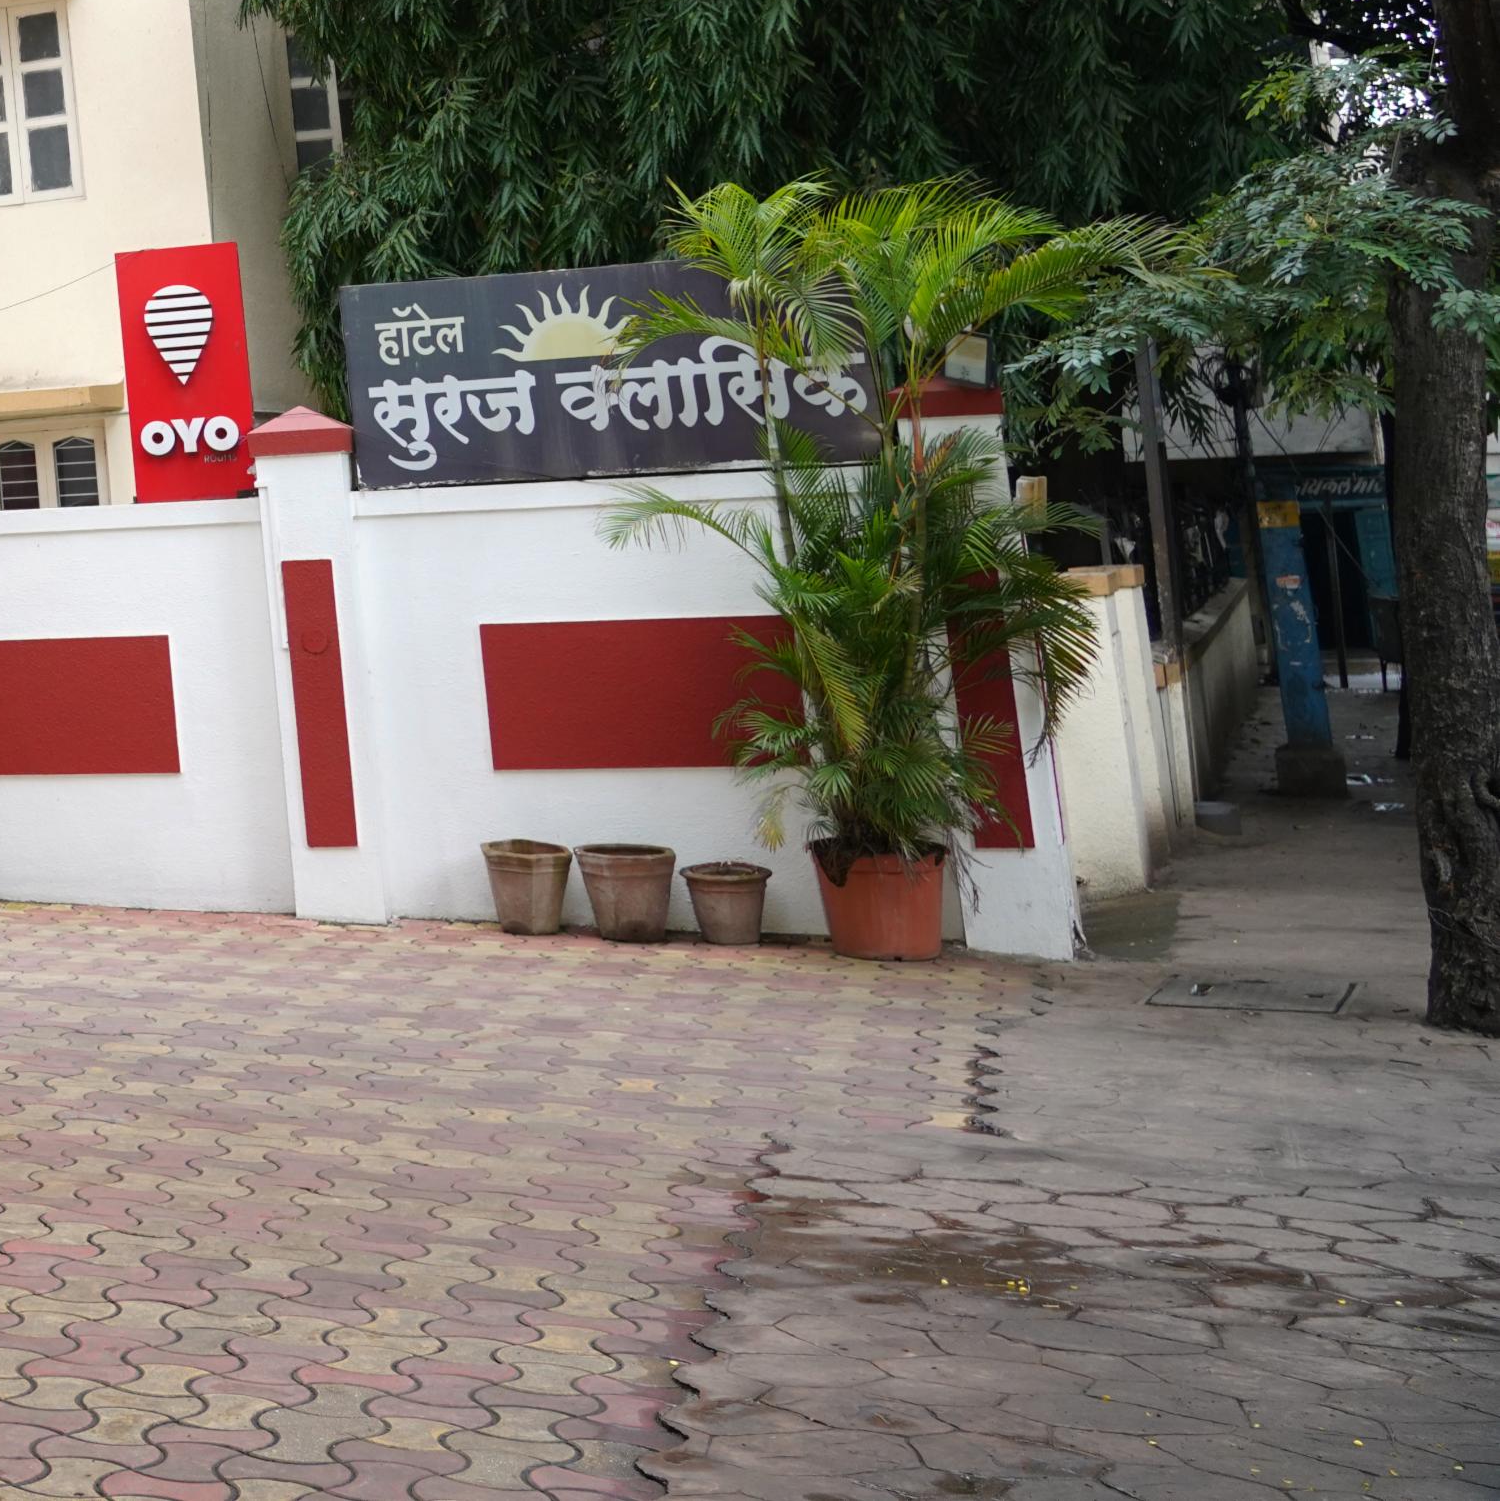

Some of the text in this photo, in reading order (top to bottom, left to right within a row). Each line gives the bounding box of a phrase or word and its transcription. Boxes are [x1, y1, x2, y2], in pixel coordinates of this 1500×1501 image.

[374, 302, 465, 366] हॉटेल
[140, 415, 240, 456] OYO
[368, 369, 536, 471] सुरज
